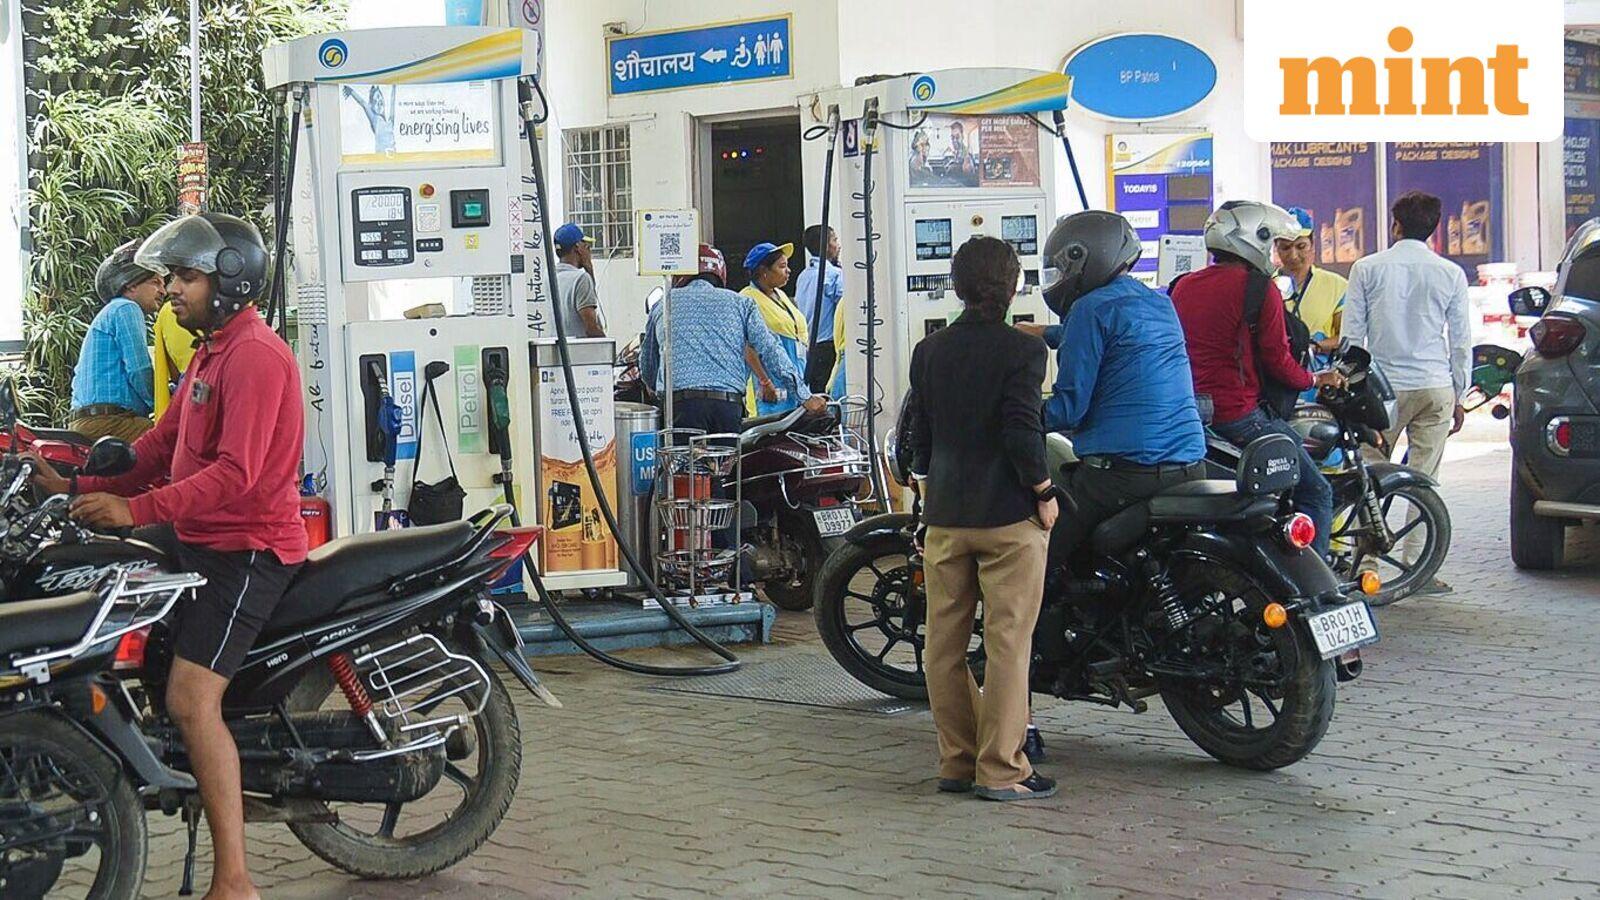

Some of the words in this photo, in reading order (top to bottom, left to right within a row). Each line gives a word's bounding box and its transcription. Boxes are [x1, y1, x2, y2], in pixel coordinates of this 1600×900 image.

[614, 50, 696, 81] शौचालय
[1120, 70, 1133, 83] BP
[399, 117, 460, 143] energising
[461, 112, 489, 134] lives
[1294, 141, 1368, 154] LUBRICANTS
[1395, 150, 1438, 161] PACKAGE
[526, 256, 546, 303] future
[527, 309, 547, 331] Ab
[309, 383, 324, 412] Ab
[461, 365, 478, 429] Petrol
[586, 385, 603, 395] points
[396, 376, 414, 438] Diesel
[551, 408, 565, 417] FREE
[634, 446, 656, 462] US
[1267, 456, 1288, 467] ROYAL
[1266, 462, 1291, 475] ENFIELD
[820, 510, 849, 522] BR01J
[824, 520, 851, 532] D9977
[1320, 605, 1363, 632] BR01H
[1325, 621, 1368, 647] U4785
